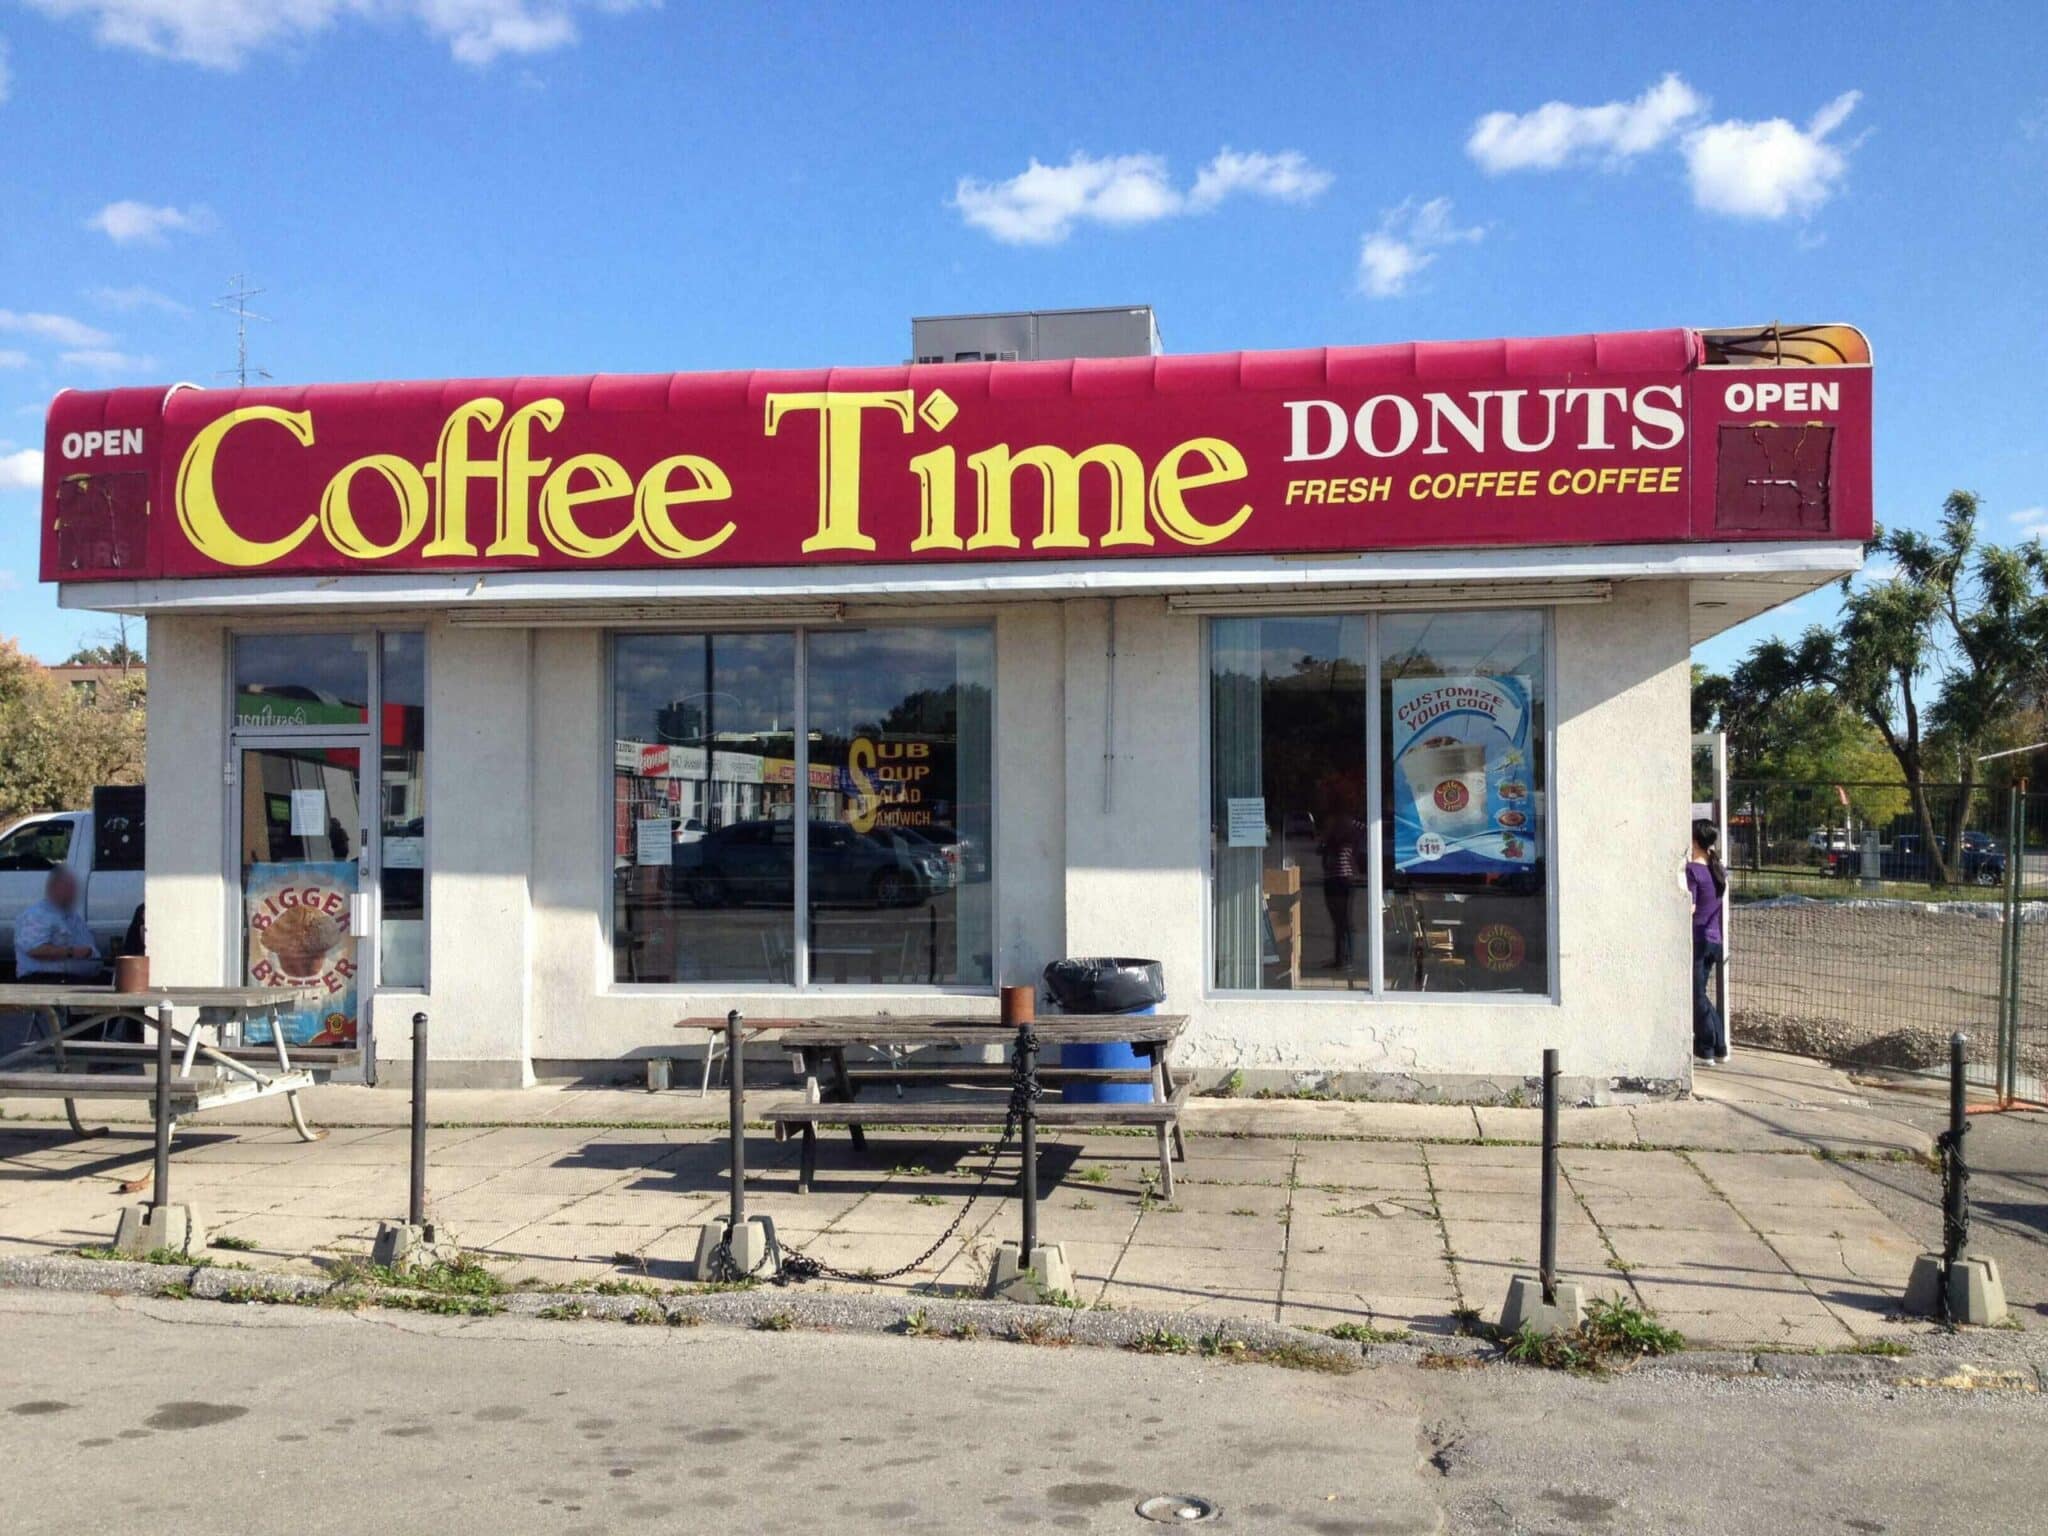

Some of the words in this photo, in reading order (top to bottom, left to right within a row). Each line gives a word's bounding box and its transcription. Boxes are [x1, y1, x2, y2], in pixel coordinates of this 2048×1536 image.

[1724, 382, 1839, 412] OPEN
[1283, 385, 1685, 462] DONUTS
[62, 427, 143, 459] OPEN
[175, 397, 737, 566] Coffee
[764, 388, 1254, 554] Time
[1285, 476, 1392, 505] FRESH
[1408, 470, 1540, 500] COFFEE
[1548, 466, 1682, 495] COFFEE
[1397, 687, 1505, 721] CUSTOMIZE
[1407, 700, 1451, 732] YOUR
[1456, 698, 1497, 717] COOL
